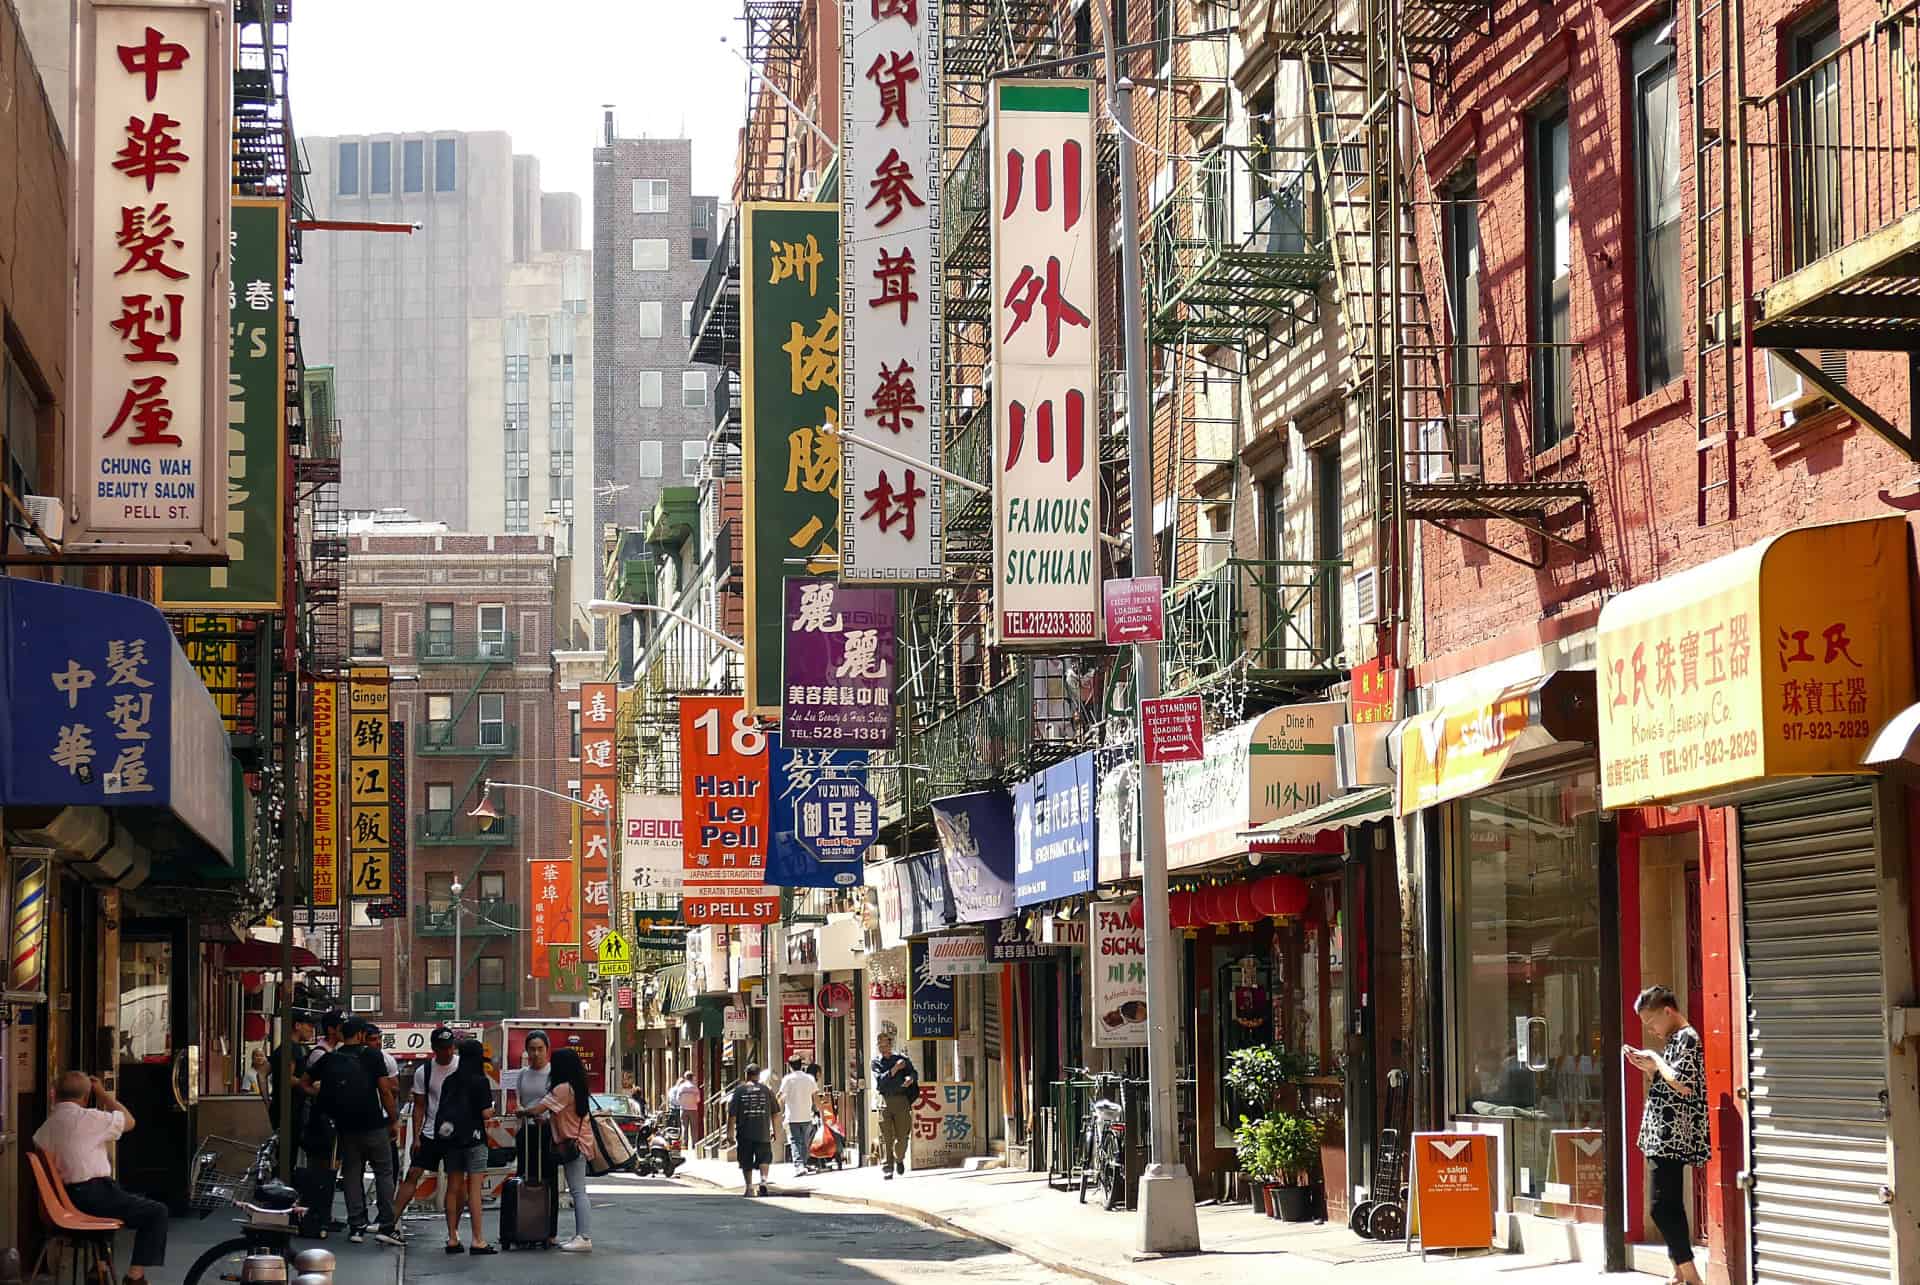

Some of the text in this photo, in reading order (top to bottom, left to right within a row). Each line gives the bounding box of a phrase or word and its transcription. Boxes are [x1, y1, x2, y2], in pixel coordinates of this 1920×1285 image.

[104, 27, 191, 448] 中華髮型屋
[1002, 139, 1091, 482] 川外川
[101, 458, 191, 475] CHUNG WAH
[98, 482, 195, 498] BEAUTY SALON
[124, 505, 189, 519] PELL ST.
[1007, 498, 1090, 534] FAMOUS
[1006, 550, 1091, 585] SICHUAN
[1114, 606, 1142, 615] LOADING
[1007, 612, 1092, 635] TEL:212-233-3888
[1114, 615, 1152, 625] UNLOADING
[352, 689, 386, 705] Ginger
[1145, 703, 1197, 714] NO STANDING
[50, 659, 96, 776] 中華
[1148, 717, 1170, 725] EXCEPT
[1286, 713, 1314, 728] Dine in
[694, 708, 767, 757] 18
[1152, 726, 1183, 734] LOADING
[1280, 725, 1286, 736] &
[1783, 719, 1869, 741] 917-923-2829
[1153, 735, 1192, 744] UNLOADING
[695, 774, 761, 798] Hair
[818, 785, 860, 797] YU ZU TANG
[314, 774, 332, 831] NOODLES
[1265, 781, 1321, 811] 川外川
[708, 801, 746, 824] Le
[629, 820, 683, 837] PELL
[701, 825, 759, 848] Pell
[626, 839, 650, 847] HAIR
[690, 870, 721, 879] JAPANESE
[699, 887, 762, 896] KERATIN TREATMENT
[710, 903, 749, 917] PELL
[753, 902, 773, 917] ST
[601, 964, 628, 972] AHEAD
[913, 1000, 950, 1011] Infinity
